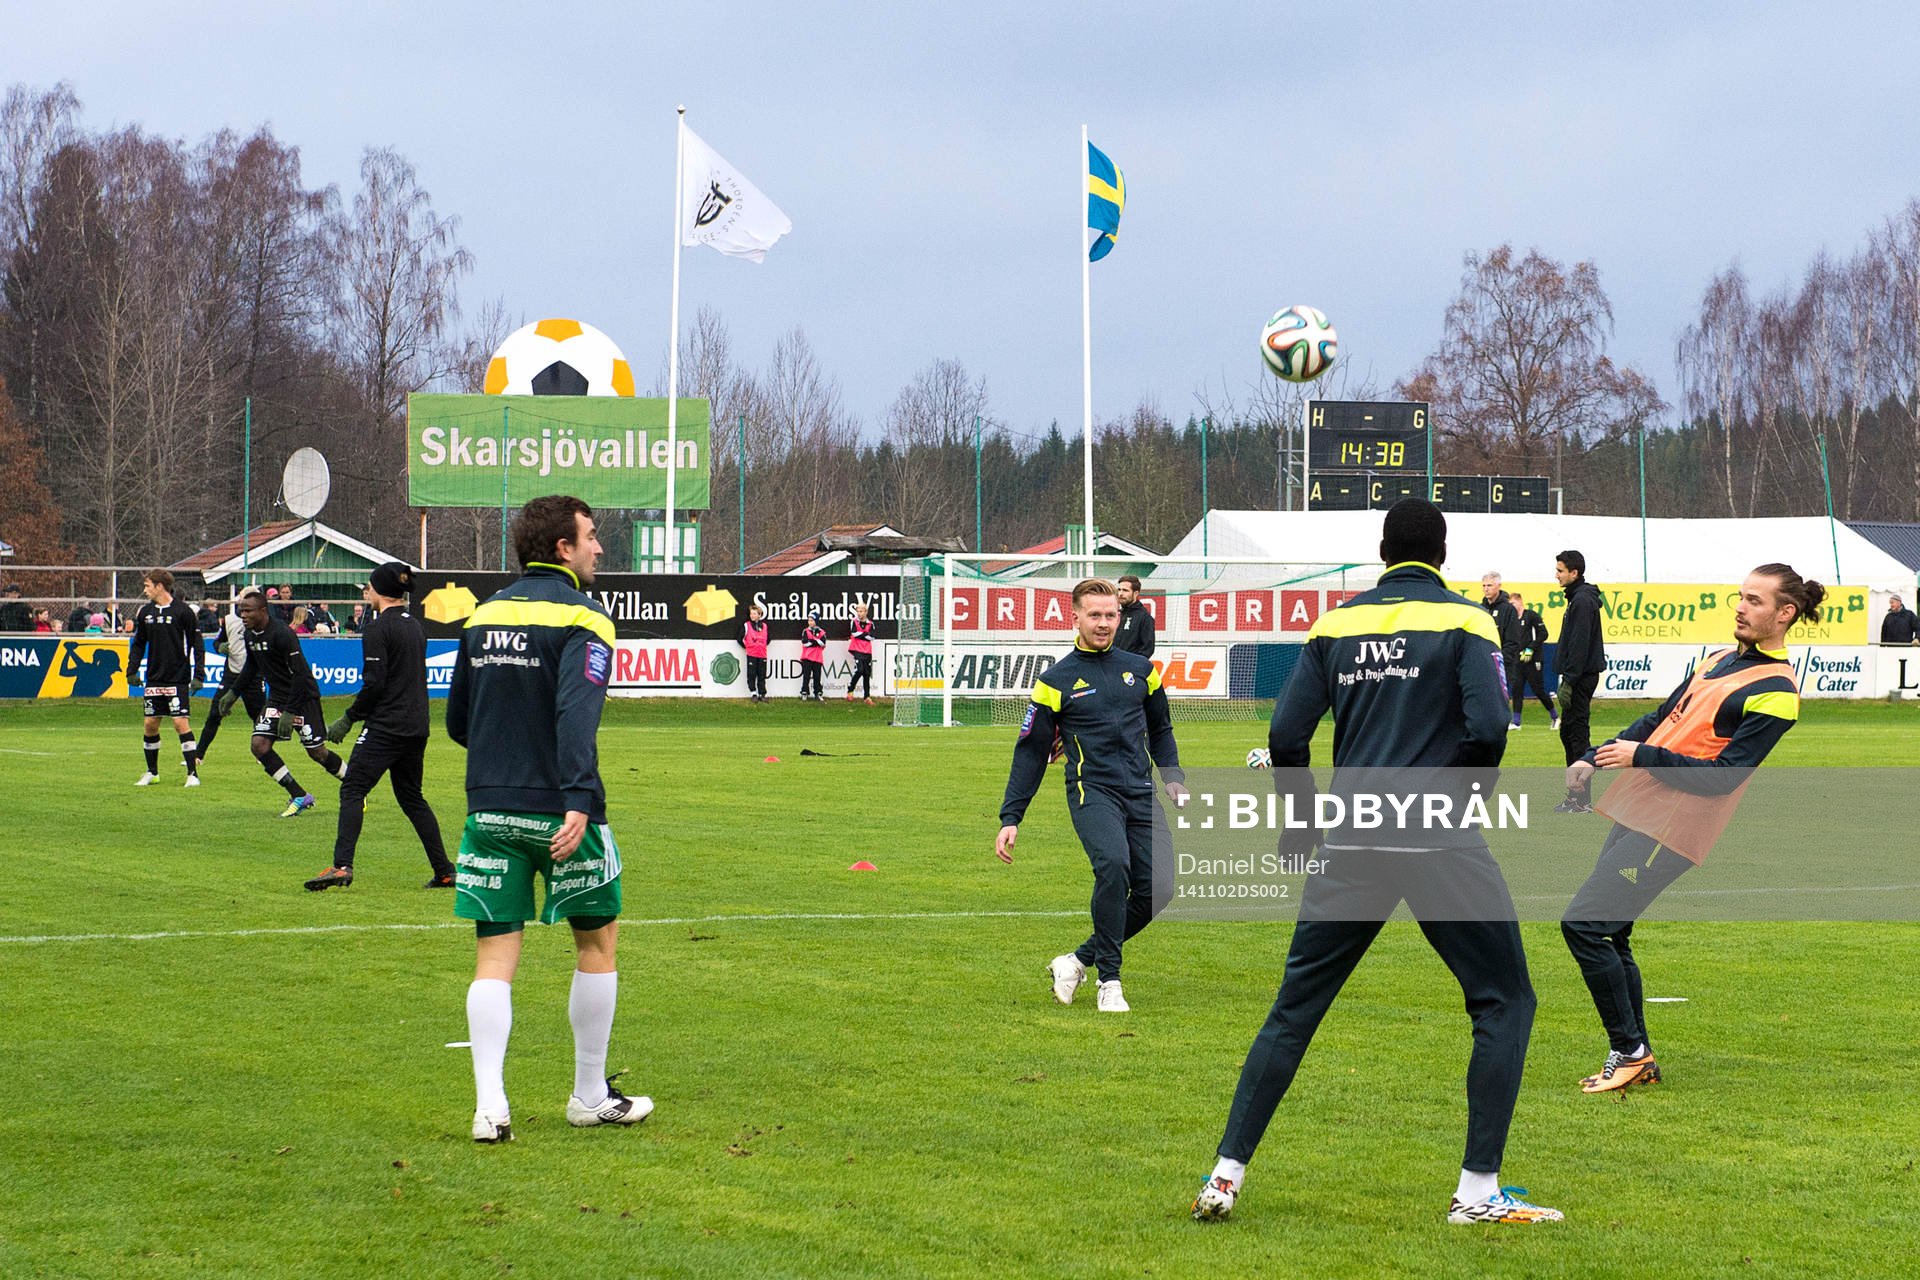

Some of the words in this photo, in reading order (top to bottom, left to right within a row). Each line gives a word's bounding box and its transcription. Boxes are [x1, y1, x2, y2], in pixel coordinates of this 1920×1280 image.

[1312, 408, 1324, 427] H
[1413, 410, 1425, 429] G
[420, 427, 698, 476] Skarsjövallen
[1341, 442, 1404, 466] 14:38
[1310, 482, 1322, 501] A
[1371, 483, 1382, 501] C
[1432, 483, 1444, 503] E
[1492, 484, 1503, 503] G
[1600, 591, 1696, 621] Nelson
[482, 630, 528, 651] JWG
[1607, 625, 1682, 637] GARDEN
[1355, 637, 1407, 664] JWG
[616, 648, 701, 681] RAMA
[1603, 654, 1652, 672] Svensk
[1809, 655, 1862, 673] Svensk
[1338, 672, 1355, 686] Bygg
[1355, 670, 1364, 681] &
[1407, 666, 1420, 678] AB
[1605, 672, 1648, 690] Cater
[1817, 674, 1858, 692] Cater
[488, 875, 502, 889] AB
[586, 874, 599, 887] AB
